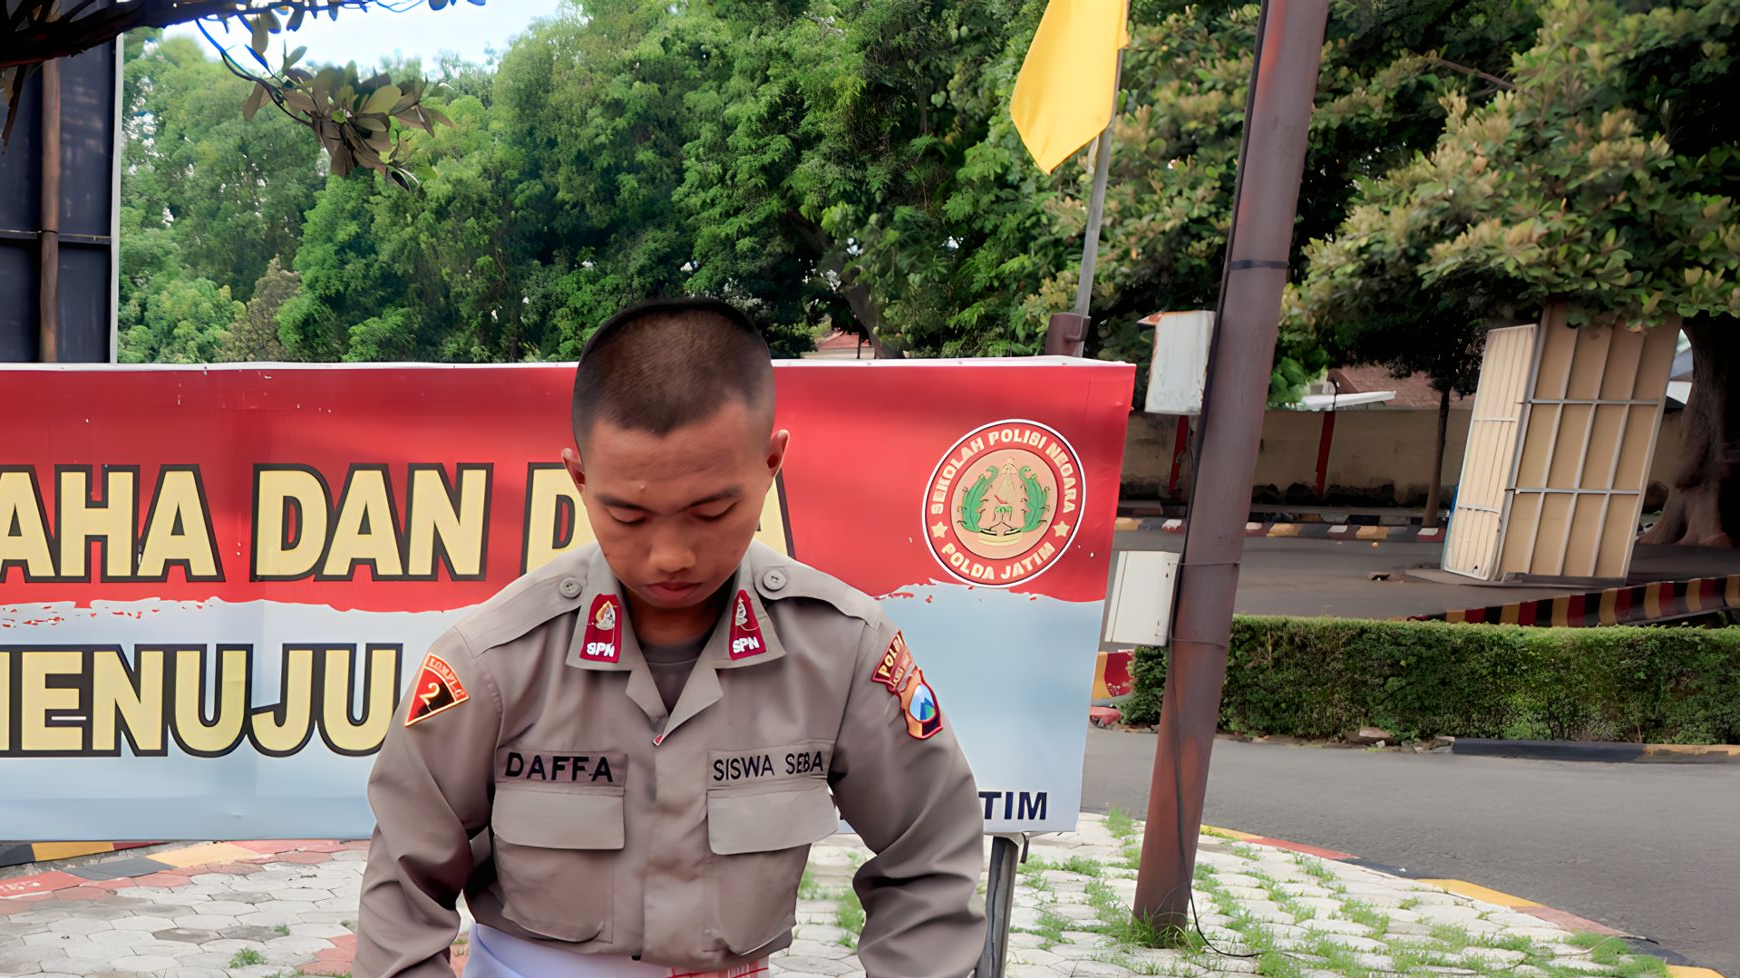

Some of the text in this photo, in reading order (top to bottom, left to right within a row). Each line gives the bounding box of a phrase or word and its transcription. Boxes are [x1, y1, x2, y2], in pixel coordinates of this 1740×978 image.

[250, 462, 494, 582] DAN
[941, 541, 1056, 580] POLDA JATIM
[586, 642, 615, 657] SPN
[732, 636, 760, 653] SPN
[419, 682, 441, 711] 2
[505, 751, 614, 783] DAFFA
[713, 750, 824, 782] SISWA SEBA
[978, 791, 1048, 820] TIM
